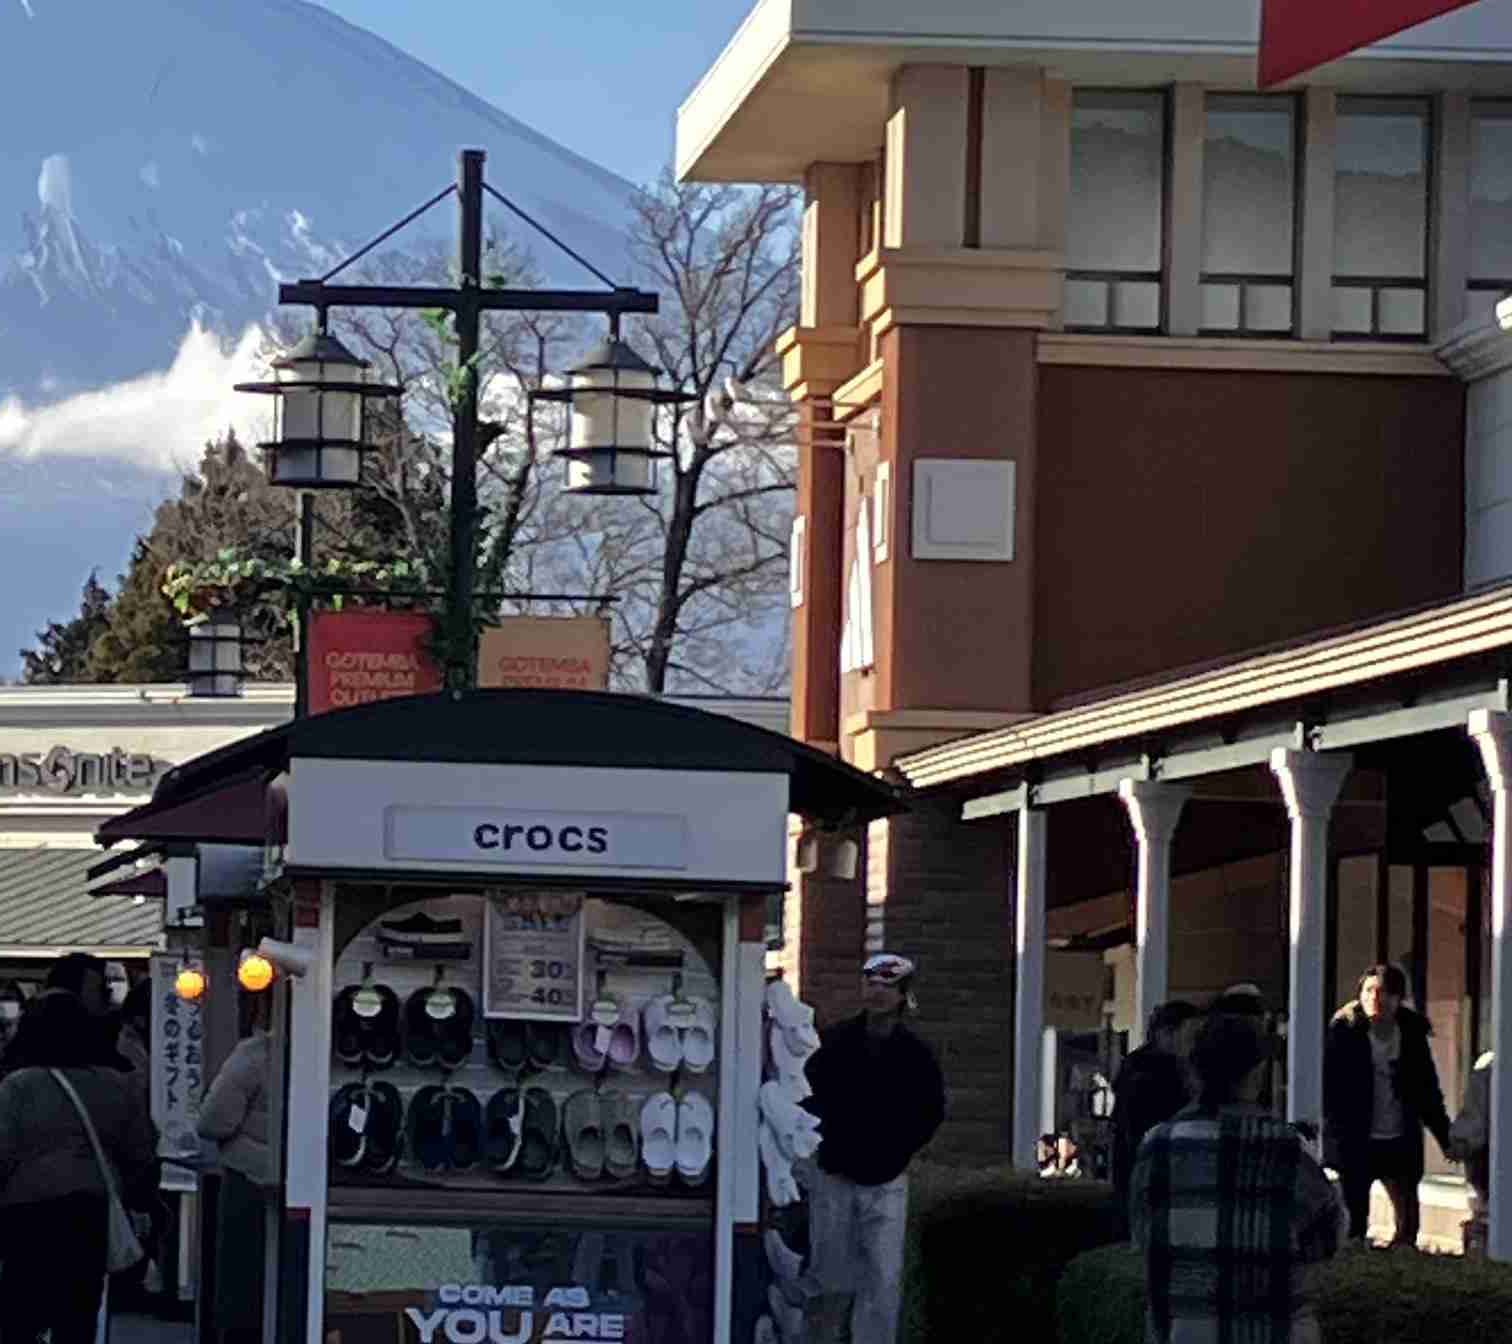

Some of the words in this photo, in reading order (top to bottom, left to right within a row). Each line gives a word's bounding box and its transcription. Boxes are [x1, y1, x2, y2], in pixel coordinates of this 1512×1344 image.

[326, 652, 420, 671] GOTEMBA
[498, 656, 592, 673] GOTEMBA
[329, 671, 415, 688] PREMIUM
[473, 822, 609, 854] crocs
[439, 1284, 534, 1306] COME
[543, 1286, 591, 1309] AS
[542, 1312, 625, 1340] ARE
